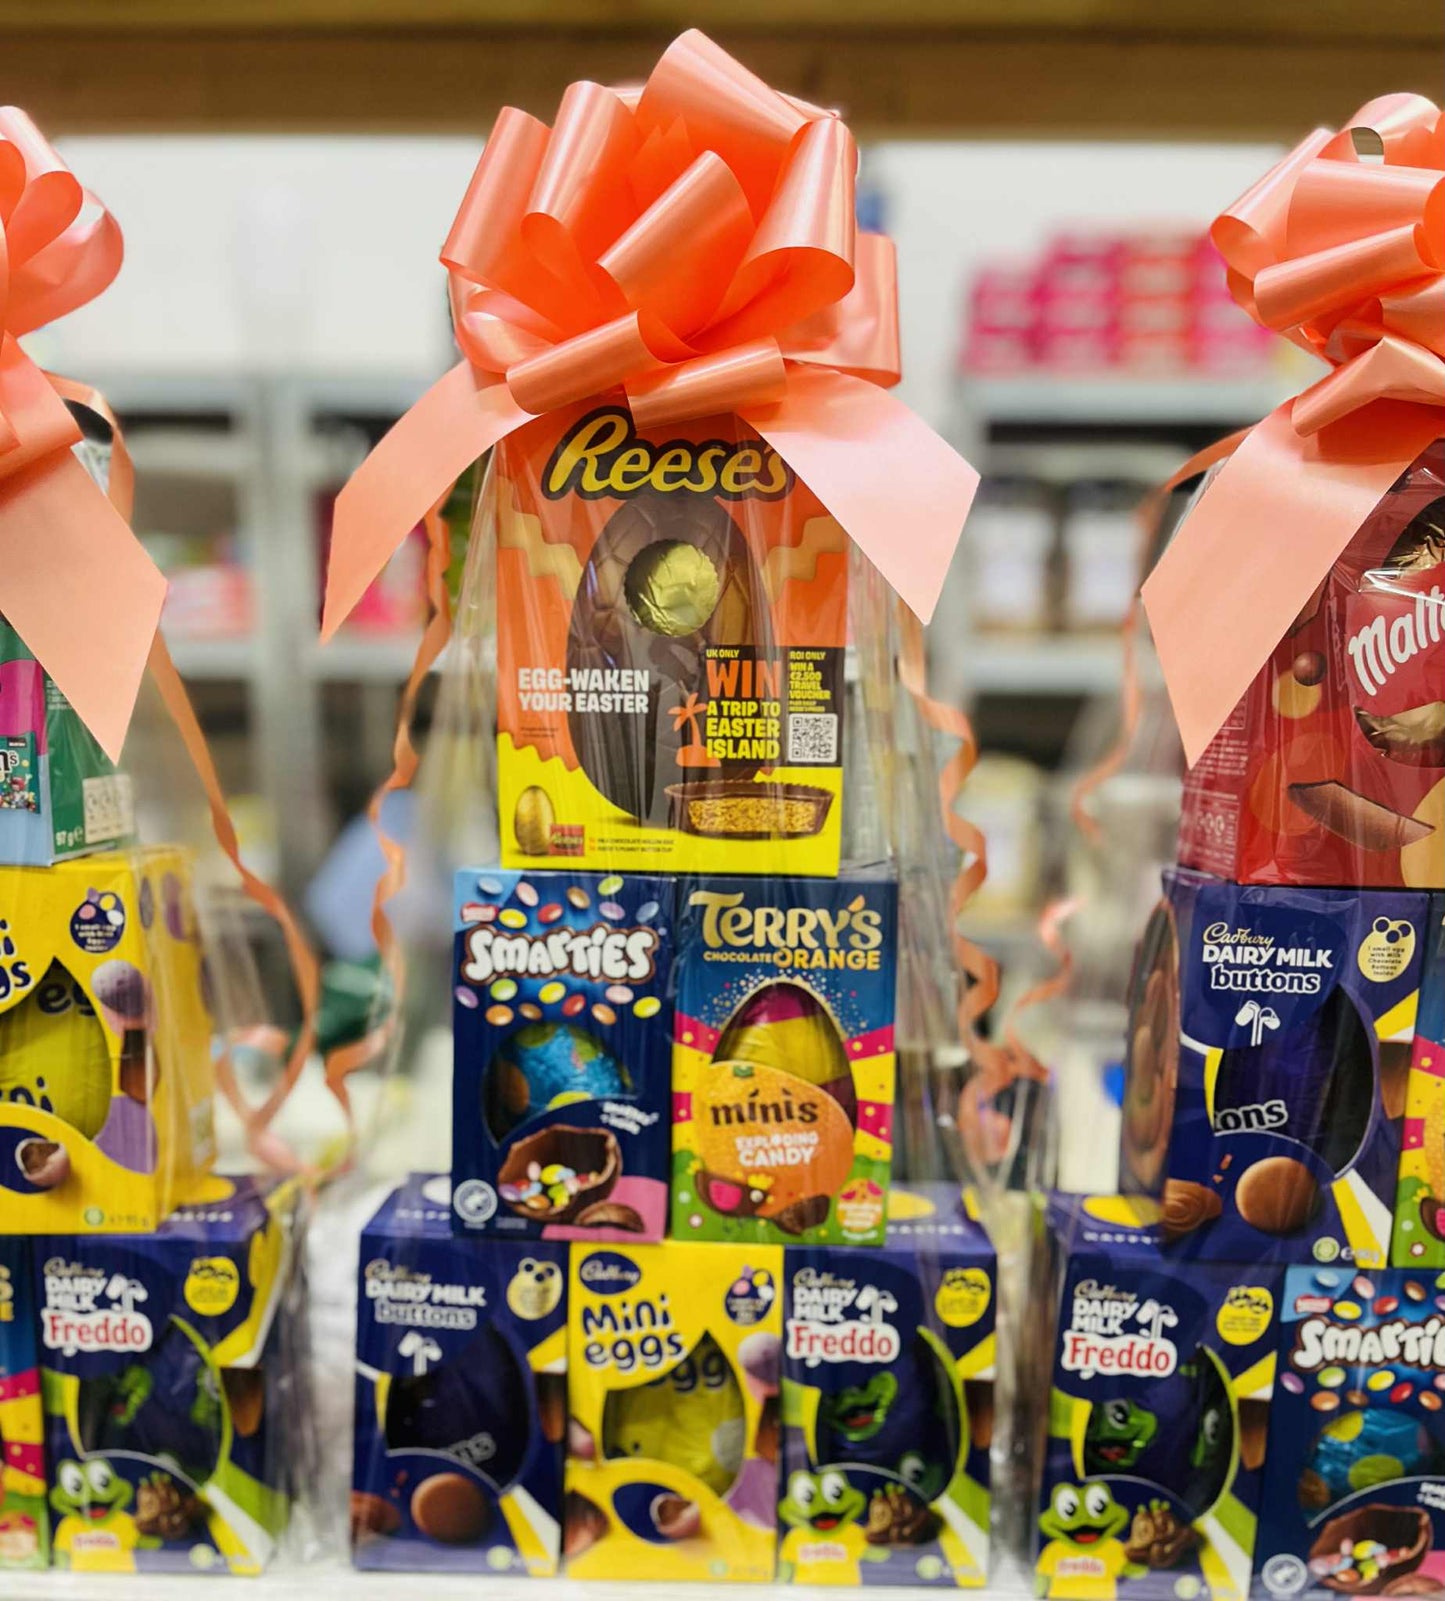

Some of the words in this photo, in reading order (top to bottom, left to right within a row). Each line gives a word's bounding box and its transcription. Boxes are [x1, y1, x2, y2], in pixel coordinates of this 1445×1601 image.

[548, 414, 790, 492] Reese's
[1348, 585, 1445, 696] Malt
[706, 649, 718, 658] UK
[719, 649, 740, 658] ONLY
[805, 651, 826, 660] ONLY
[789, 662, 807, 671] WIN
[808, 662, 814, 671] A
[518, 668, 649, 692] EGG-WAKEN
[706, 659, 782, 698] WIN
[789, 681, 822, 690] TRAVEL
[518, 692, 572, 713] YOUR
[575, 693, 649, 714] EASTER
[789, 690, 831, 700] VOUCHER
[706, 701, 718, 716] A
[721, 701, 758, 716] TRIP
[760, 701, 781, 717] TO
[706, 718, 781, 738] EASTER
[706, 739, 781, 760] ISLAND
[1202, 921, 1275, 948] Cadbury
[703, 950, 771, 963] CHOCOLATE
[772, 948, 881, 970] ORANGE
[1202, 945, 1276, 965] DAIRY
[1275, 947, 1333, 968] MILK
[1211, 963, 1321, 994] buttons
[735, 1131, 819, 1151] EXPLODING
[739, 1147, 815, 1167] CANDY
[45, 1276, 108, 1295] DAIRY
[366, 1279, 433, 1303] DAIRY
[432, 1284, 487, 1307] MILK
[46, 1293, 98, 1310] MILK
[794, 1287, 858, 1306] DAIRY
[375, 1301, 477, 1329] buttons
[583, 1294, 671, 1336] Mini
[794, 1303, 845, 1322] MILK
[1073, 1299, 1139, 1320] DAIRY
[49, 1315, 147, 1345] Freddo
[1071, 1315, 1124, 1336] MILK
[585, 1333, 684, 1370] eggs
[793, 1326, 892, 1357] Freddo
[1069, 1336, 1171, 1372] Freddo
